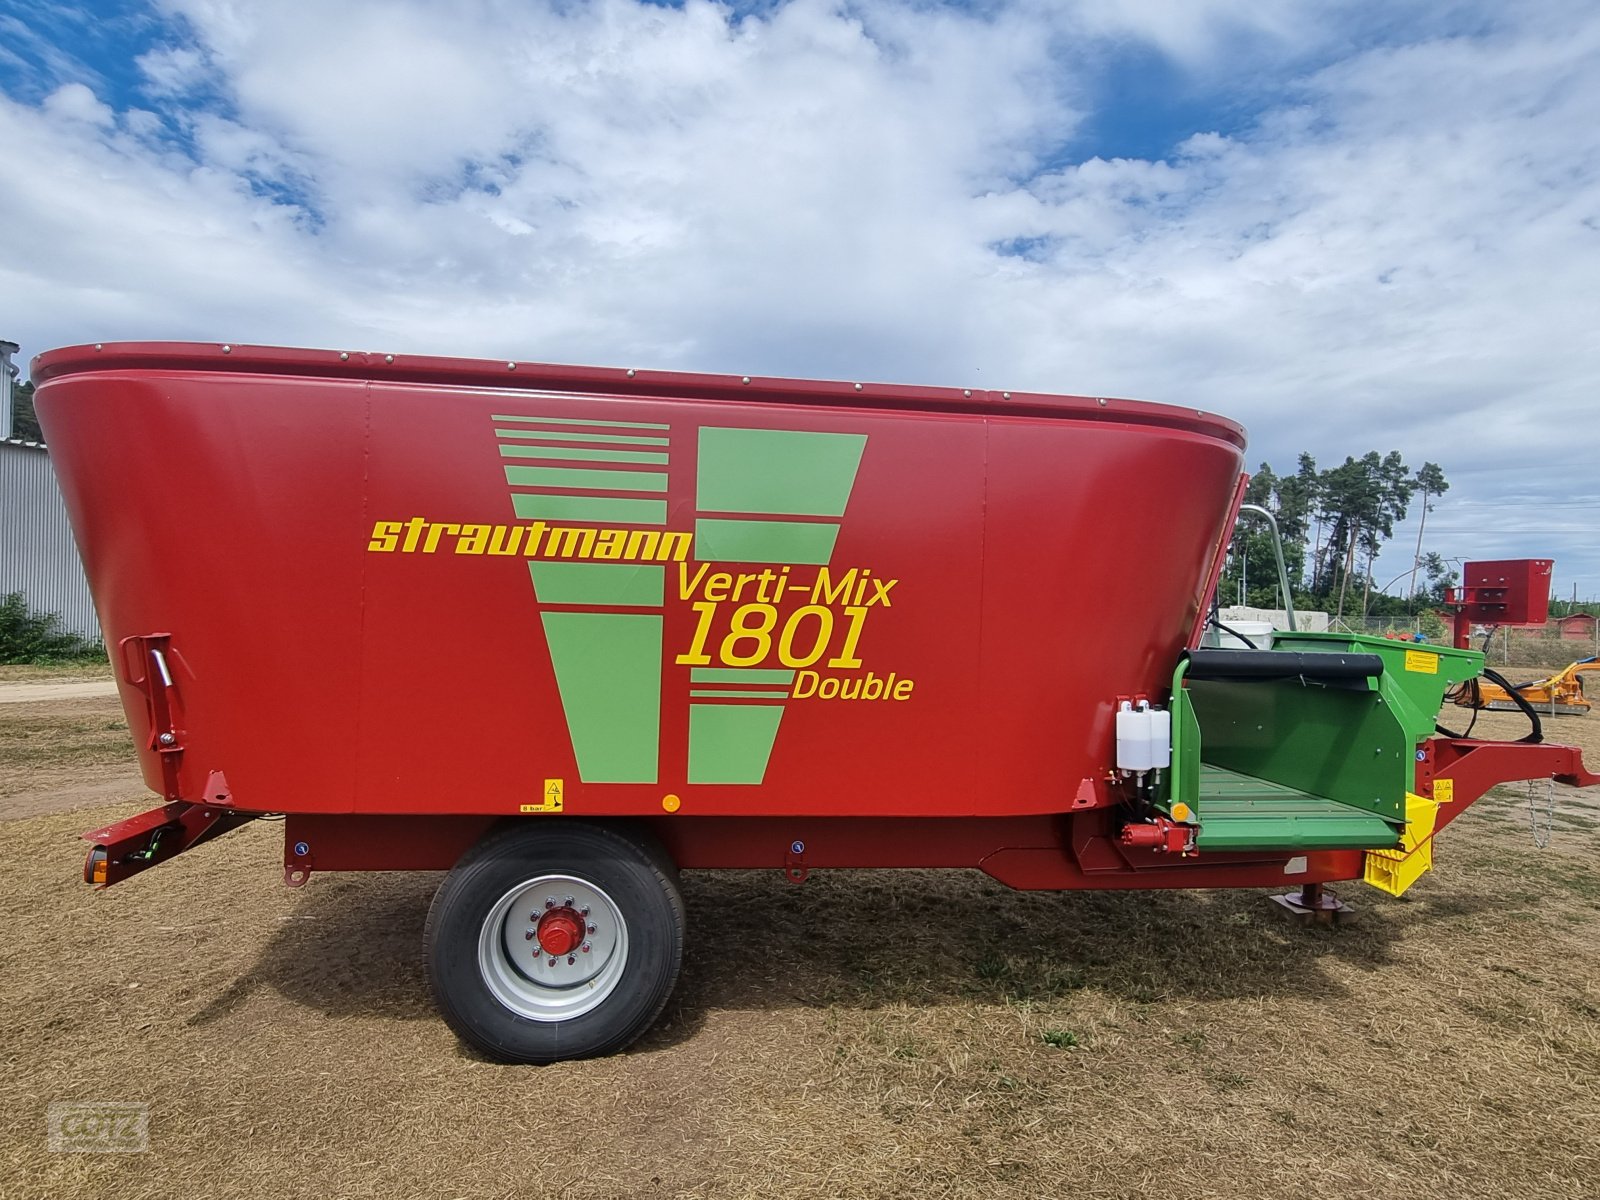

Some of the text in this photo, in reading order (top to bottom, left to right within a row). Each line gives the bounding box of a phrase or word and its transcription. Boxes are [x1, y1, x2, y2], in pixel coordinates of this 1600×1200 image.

[367, 517, 694, 562] strautmann
[676, 561, 898, 608] Verti-Mix
[674, 601, 869, 669] 1801
[792, 670, 914, 701] Double
